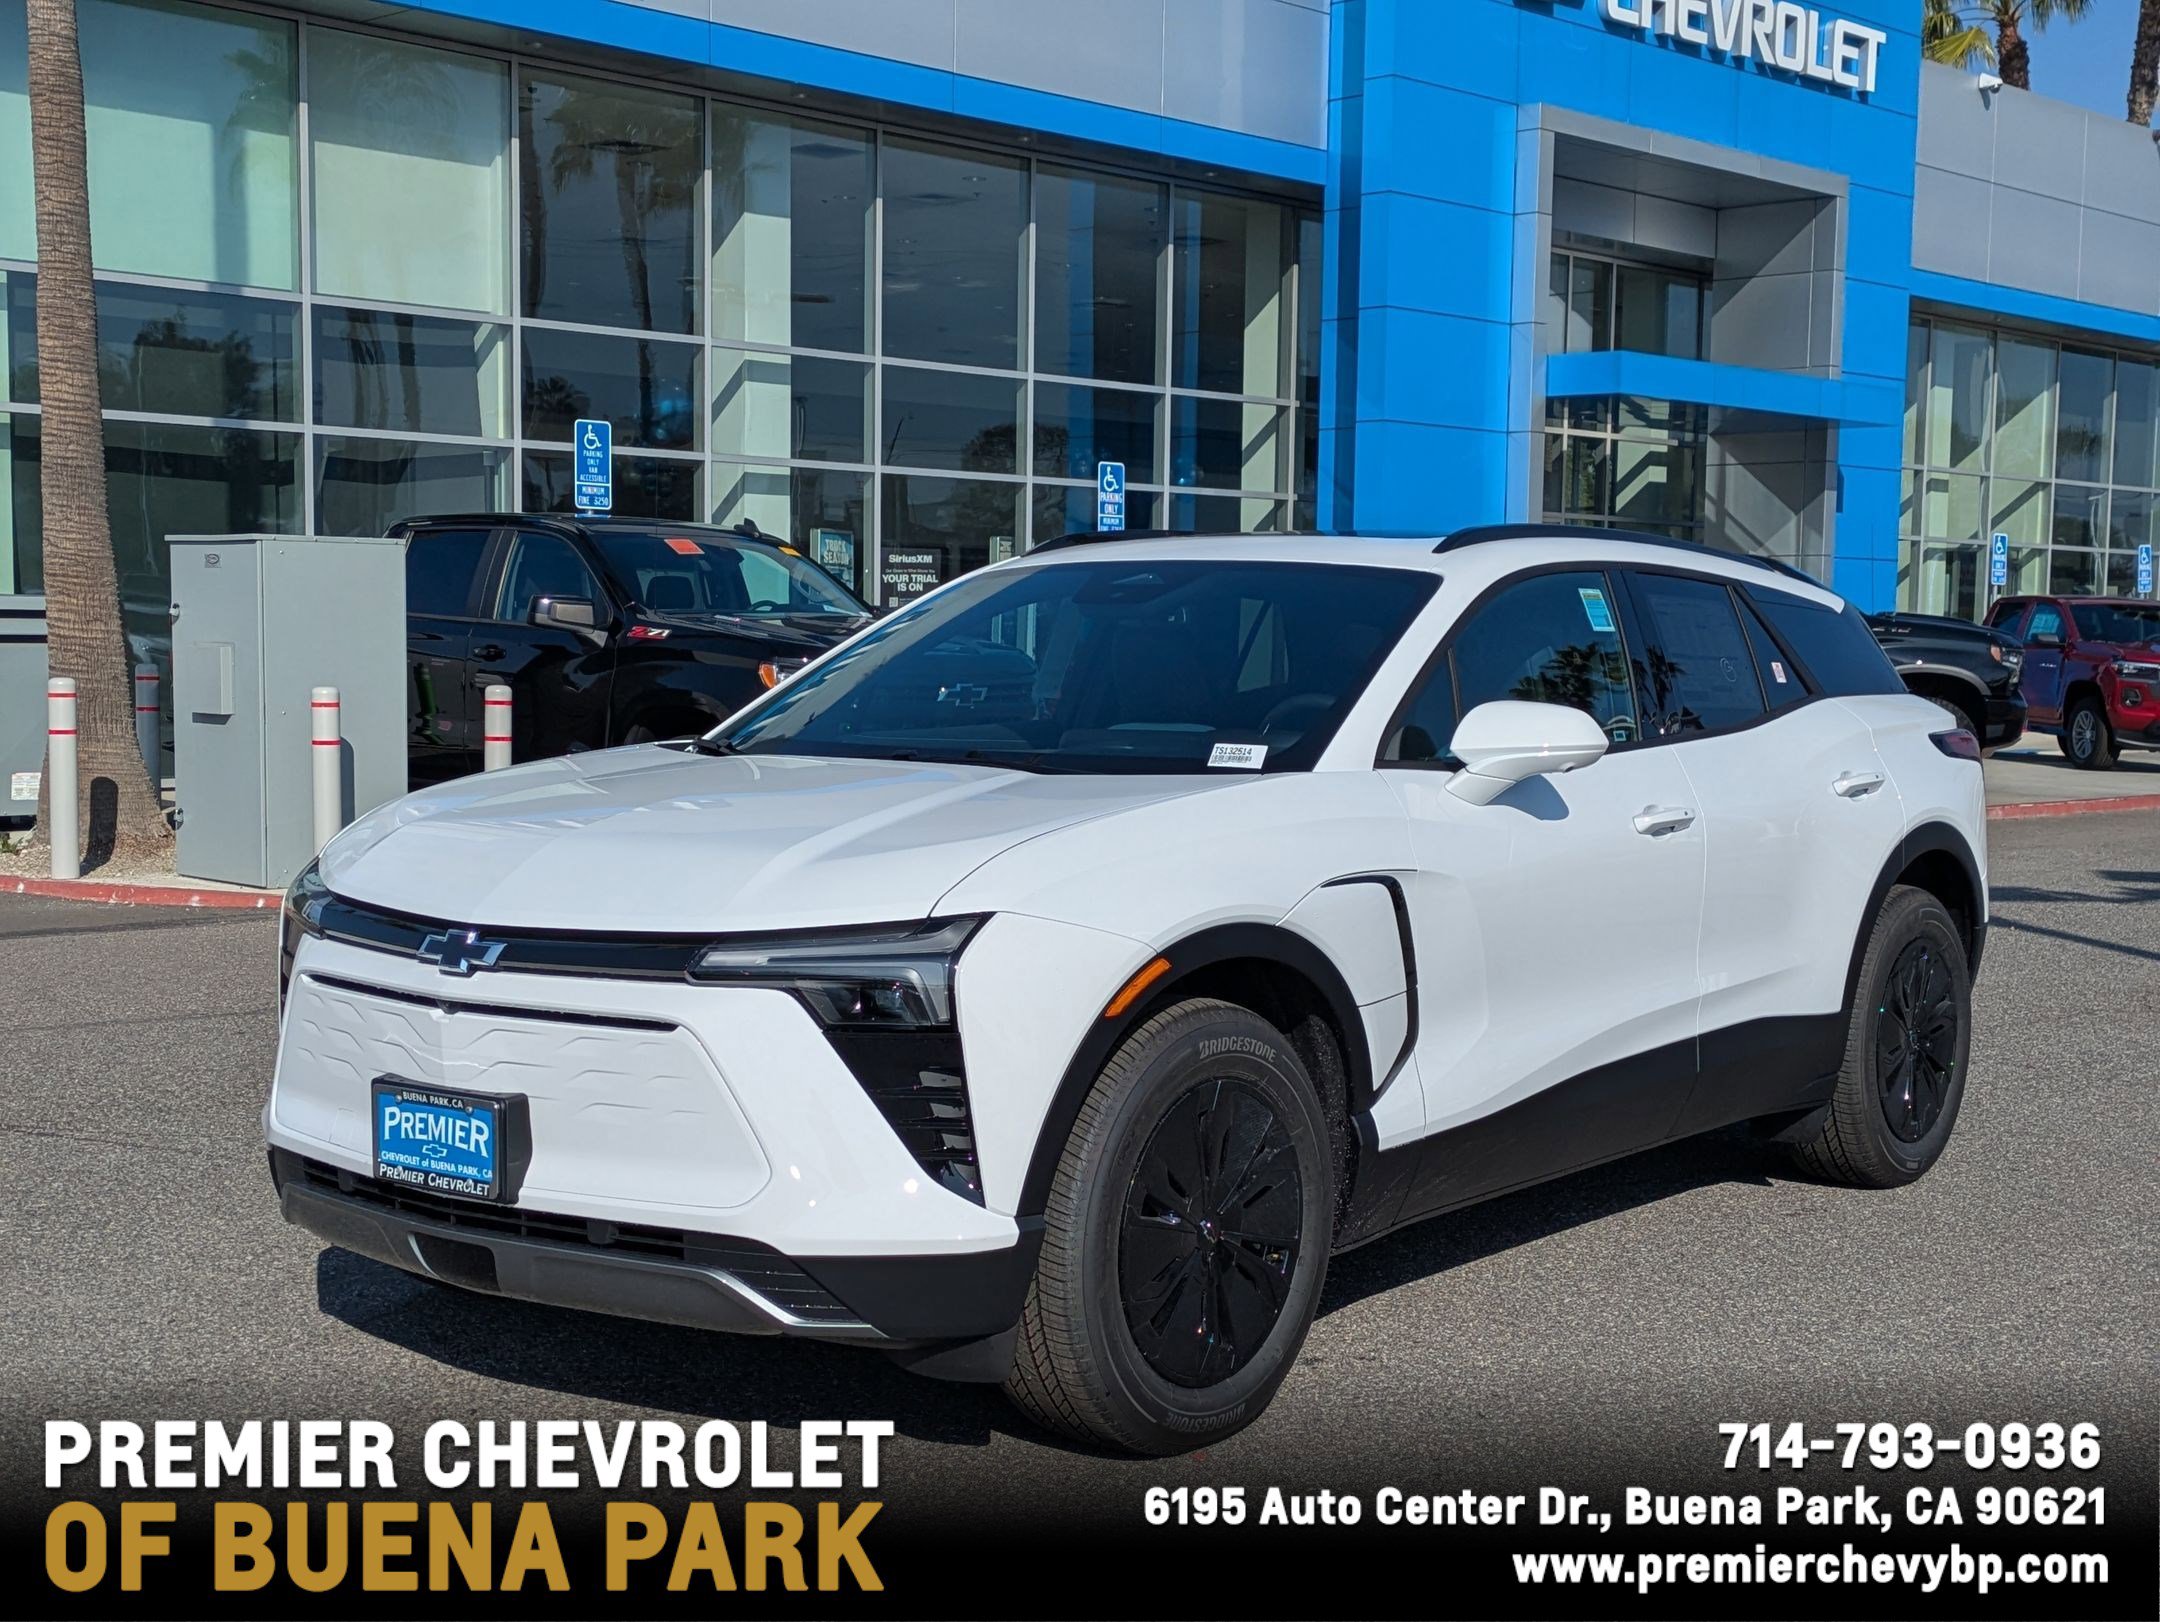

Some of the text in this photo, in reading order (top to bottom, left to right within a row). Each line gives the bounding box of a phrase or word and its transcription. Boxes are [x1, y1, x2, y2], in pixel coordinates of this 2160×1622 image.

[583, 450, 603, 458] PARKING
[587, 458, 599, 466] ONLY
[579, 496, 590, 505] FINE
[1100, 492, 1123, 503] PARKING
[1104, 503, 1118, 514] ONLY
[888, 554, 933, 563] SiriusXM
[882, 574, 938, 583] YOUR TRIAL
[897, 583, 923, 591] IS ON
[627, 626, 671, 639] Z71
[1199, 1036, 1277, 1062] BRIDGESTONE
[402, 1091, 428, 1103] BUENA
[384, 1106, 490, 1158] PREMIER
[381, 1151, 420, 1166] CHEVROLET
[421, 1158, 429, 1167] of
[430, 1160, 456, 1172] BUENA
[482, 1168, 493, 1179] CA
[379, 1163, 490, 1196] PREMIER CHEVROLET
